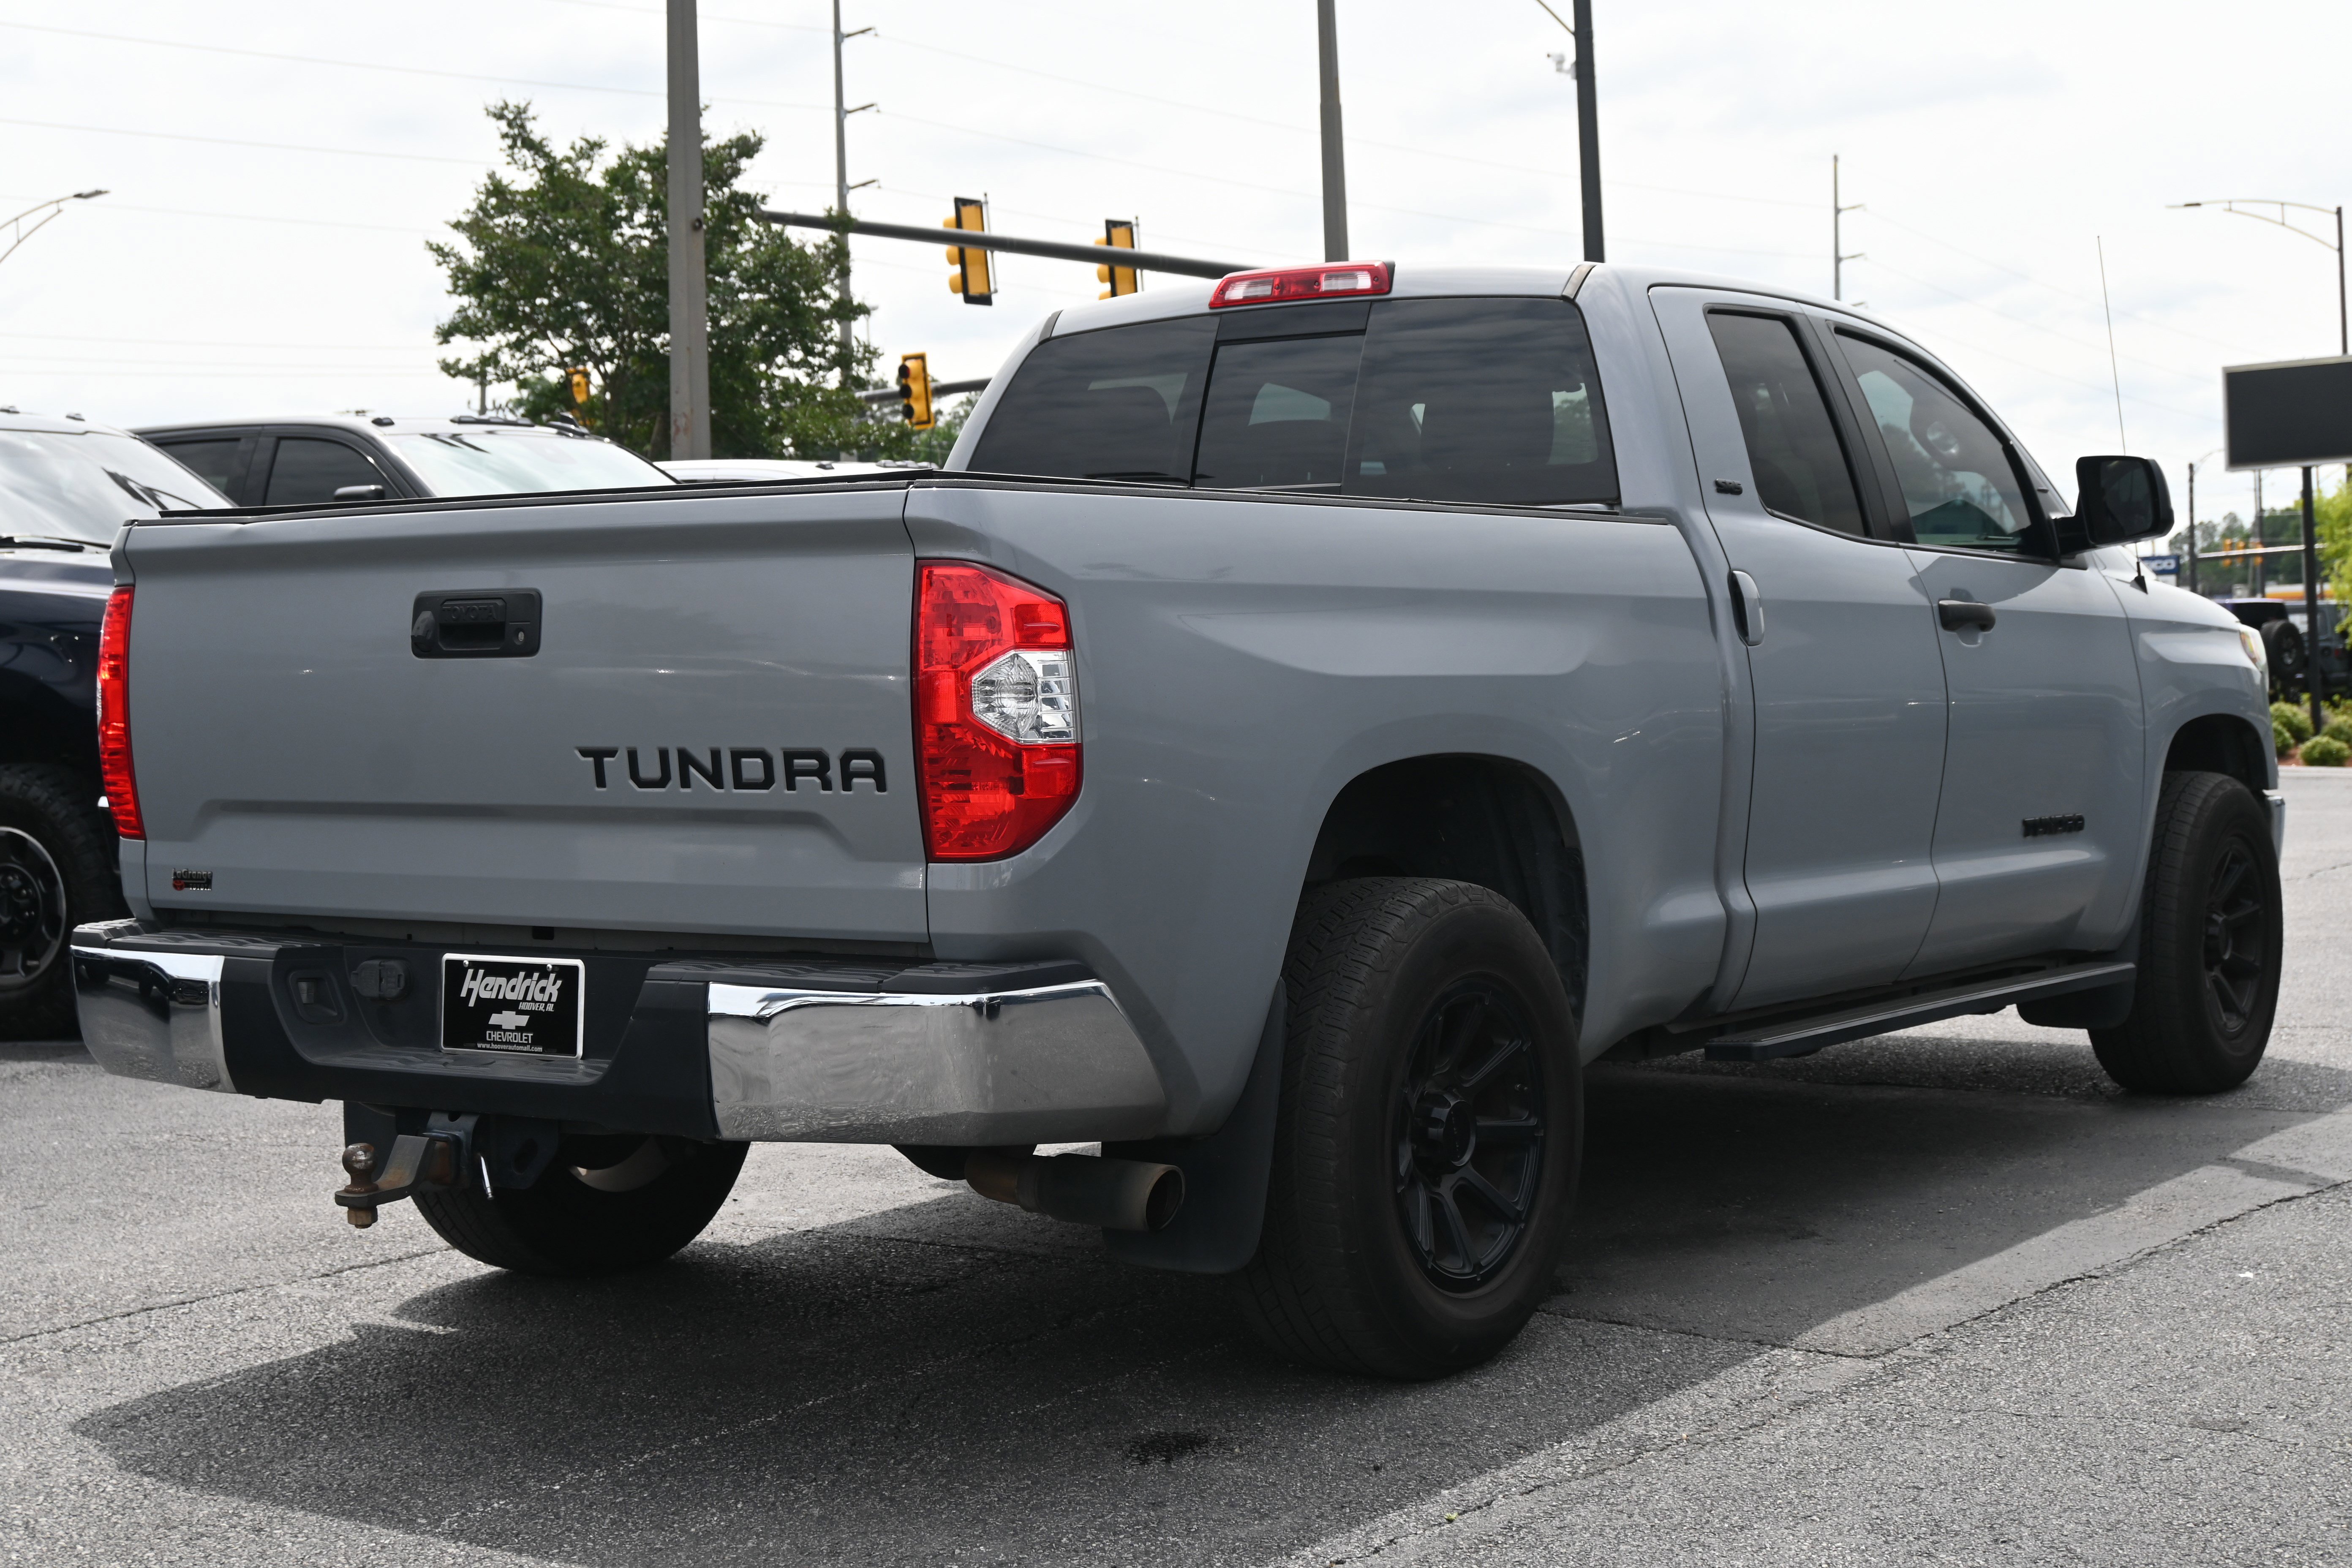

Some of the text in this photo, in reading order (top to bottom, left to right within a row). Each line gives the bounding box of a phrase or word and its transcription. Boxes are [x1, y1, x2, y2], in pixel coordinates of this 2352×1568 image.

[442, 605, 497, 621] TOYOTA
[575, 747, 887, 794] TUNDRA
[172, 868, 212, 882] LaGrange
[460, 969, 562, 1007] Hendrick
[518, 1002, 554, 1012] HOOVER, AL
[486, 1031, 533, 1043] CHEVROLET
[477, 1043, 542, 1052] www.hooverautomall.com
